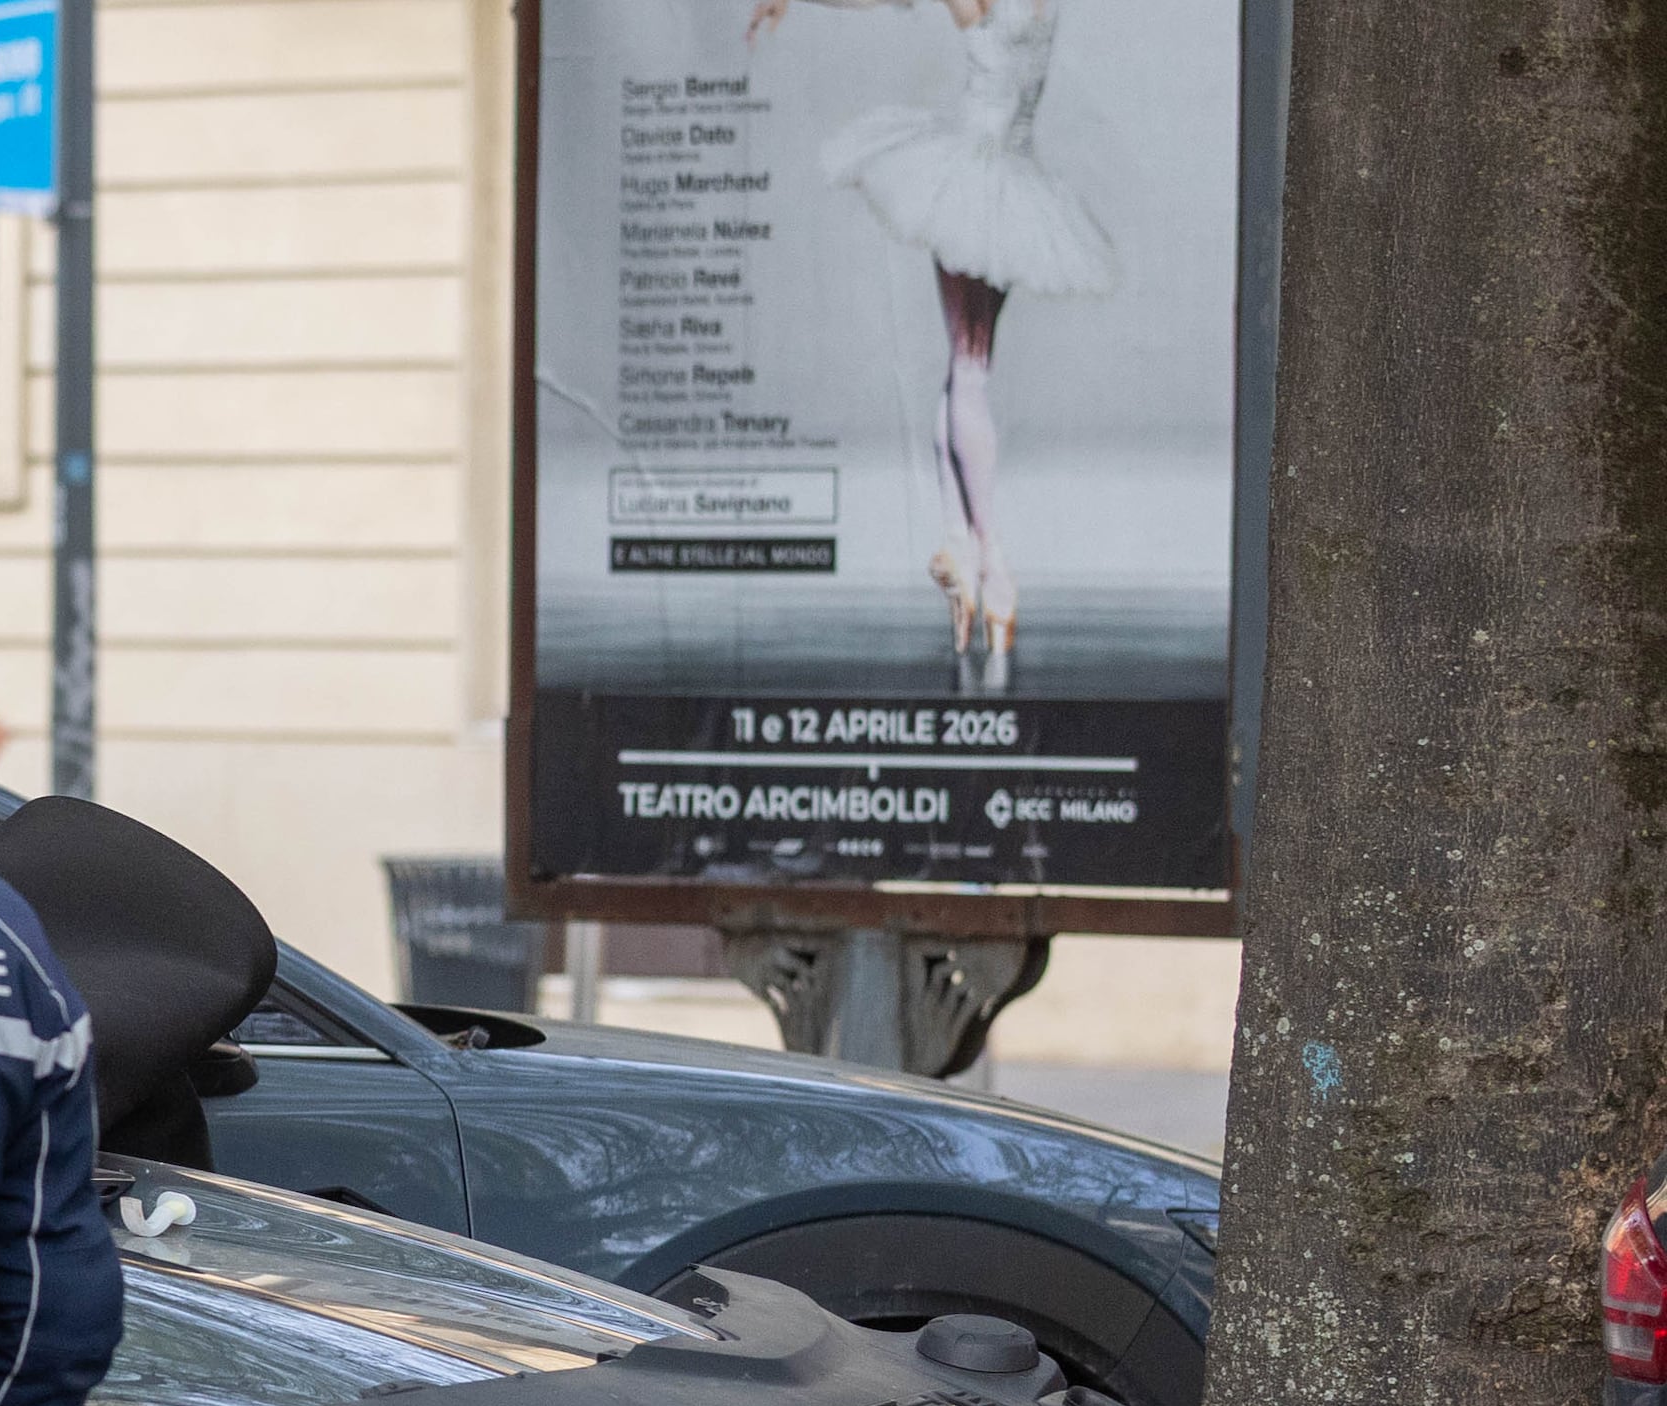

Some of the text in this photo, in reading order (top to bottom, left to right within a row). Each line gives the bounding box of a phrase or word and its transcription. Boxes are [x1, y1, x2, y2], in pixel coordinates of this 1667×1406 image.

[684, 75, 748, 97] Bernal
[689, 123, 735, 145] Dato
[675, 171, 770, 192] Marchand
[731, 707, 1019, 746] 11 e 12 APRILE 2026
[618, 782, 950, 823] TEATRO ARCIMBOLDI
[1059, 799, 1139, 824] MILANO
